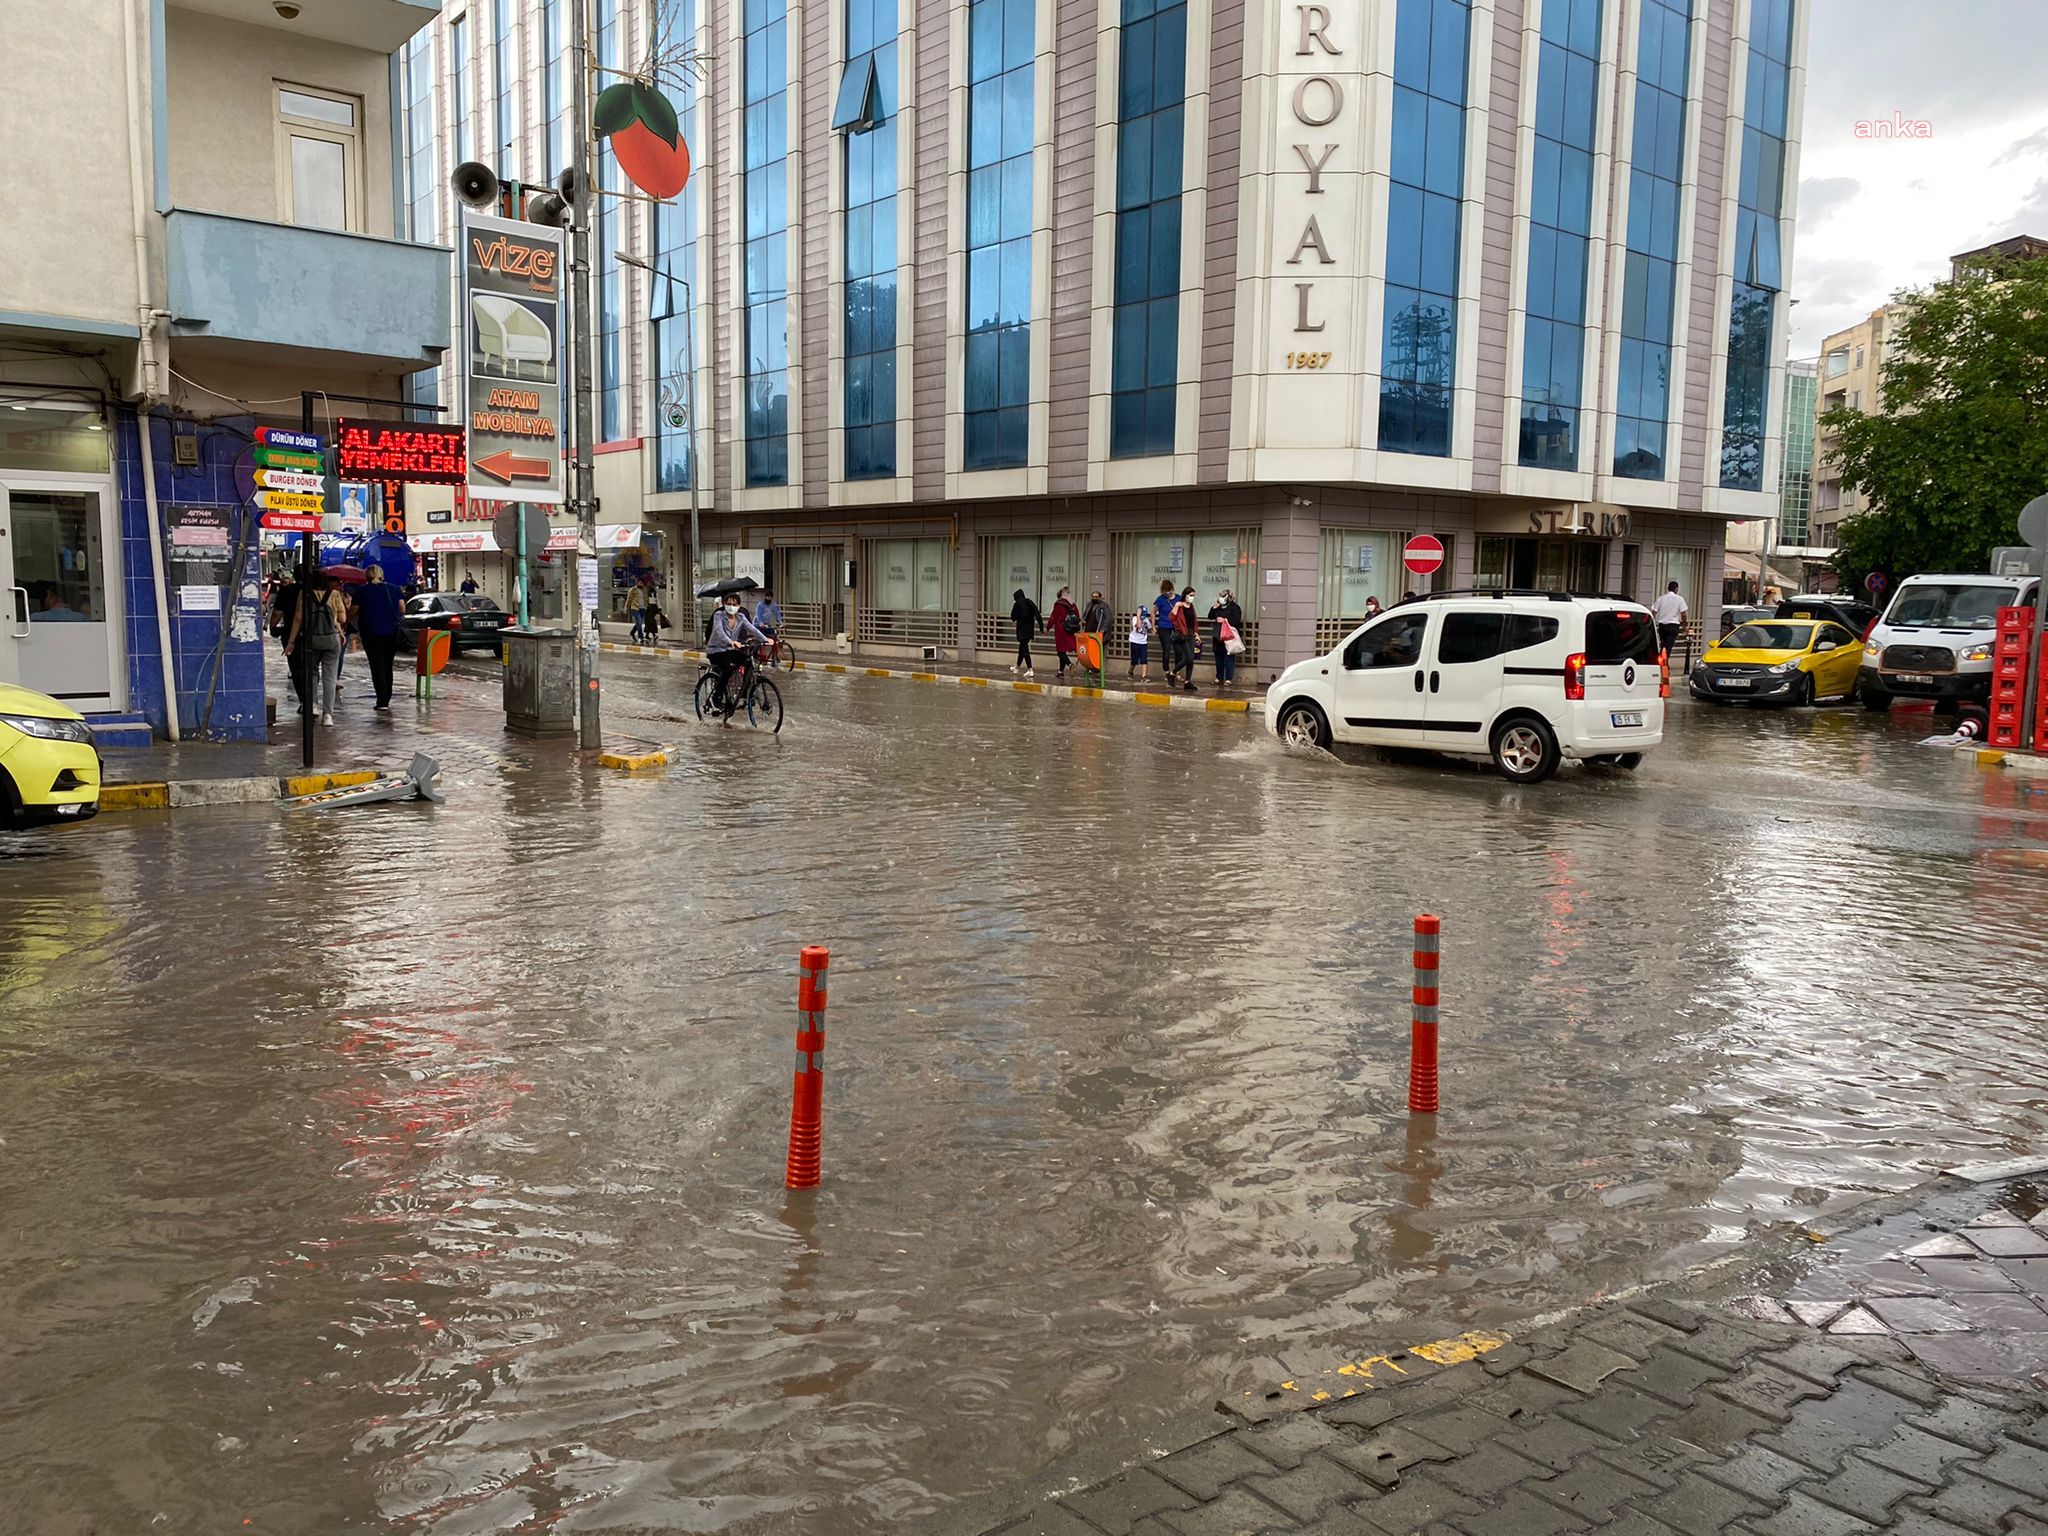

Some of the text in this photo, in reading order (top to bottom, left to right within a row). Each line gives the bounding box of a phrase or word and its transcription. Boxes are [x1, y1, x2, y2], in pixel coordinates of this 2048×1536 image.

[1286, 4, 1343, 332] ROYAL
[473, 236, 553, 278] vize
[1286, 351, 1333, 369] 1987
[488, 388, 539, 411] ATAM
[473, 411, 555, 437] MOBİLYA
[271, 432, 318, 448] DÜRÜM DÖNER
[344, 428, 460, 454] ALAKART
[270, 474, 317, 487] BURGER DÖNER
[300, 498, 317, 509] DÖNER
[1206, 565, 1226, 573] HOTEL
